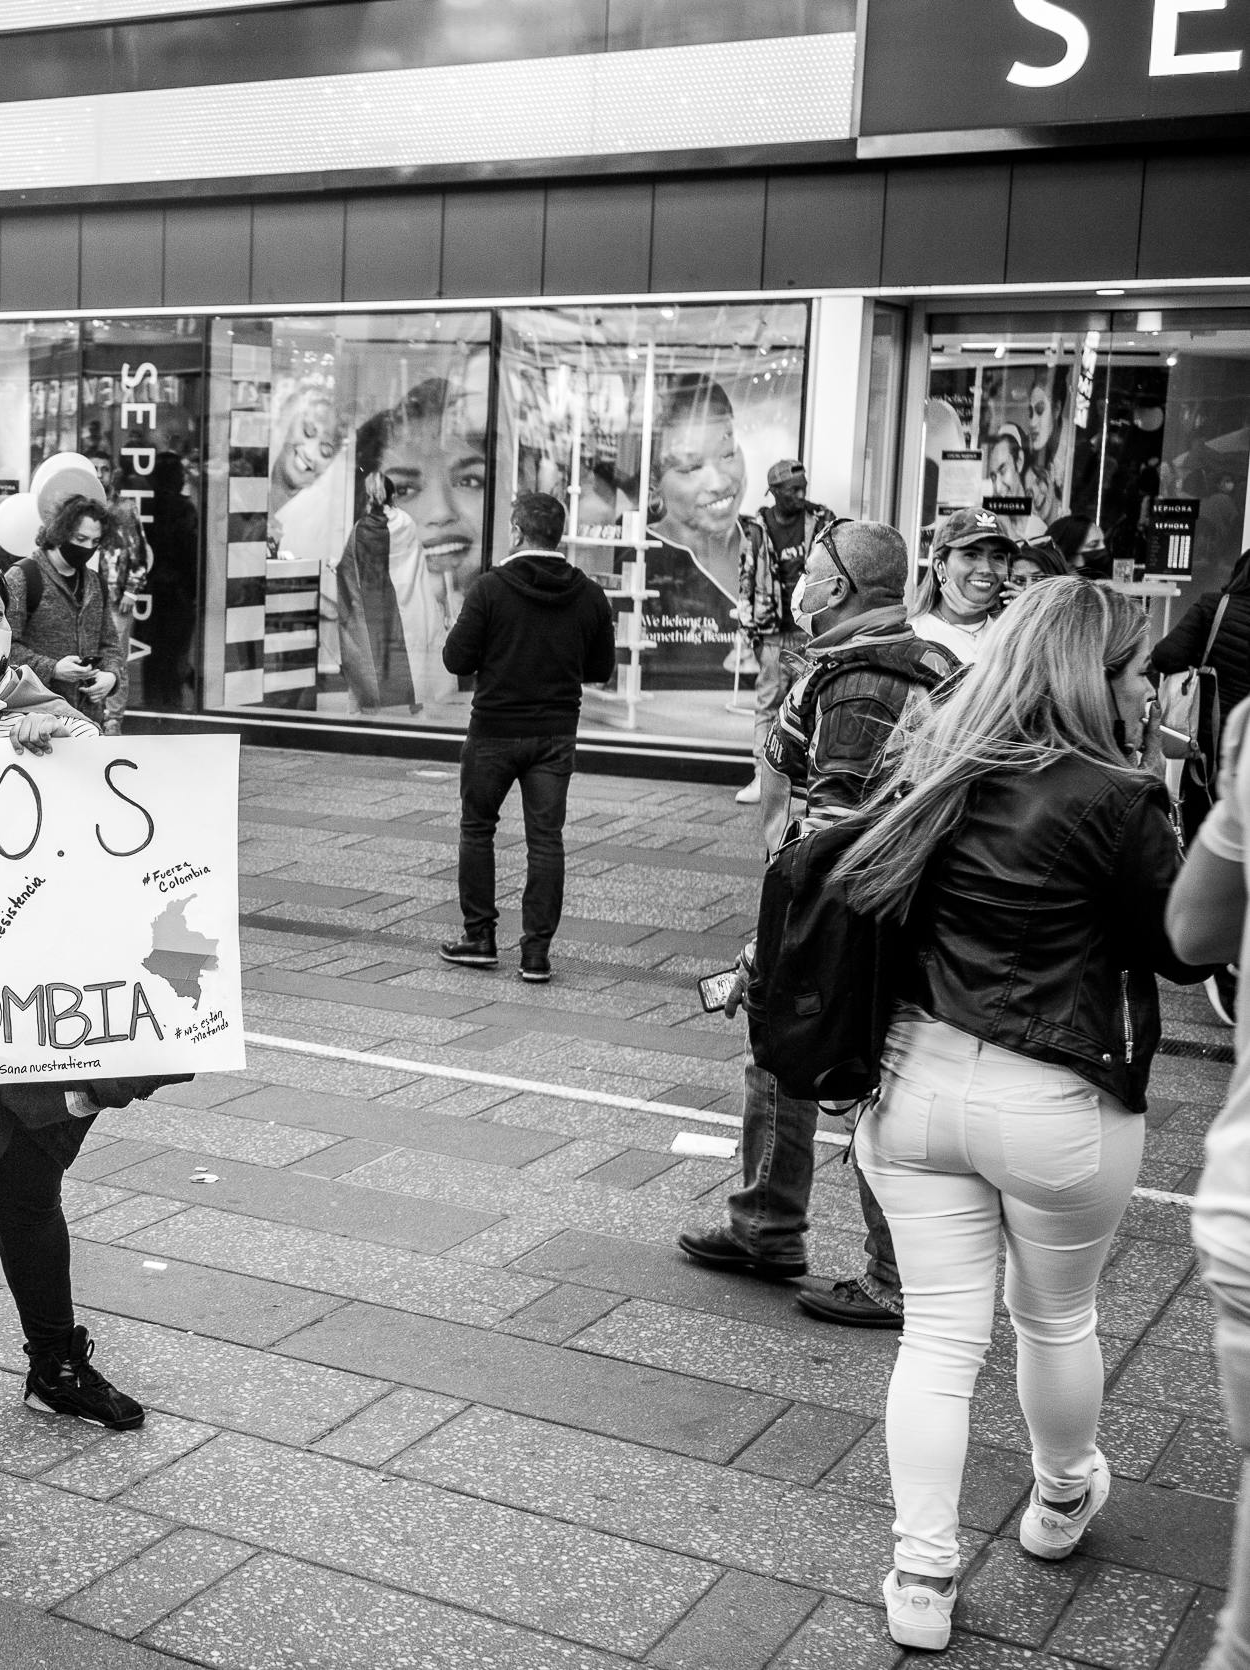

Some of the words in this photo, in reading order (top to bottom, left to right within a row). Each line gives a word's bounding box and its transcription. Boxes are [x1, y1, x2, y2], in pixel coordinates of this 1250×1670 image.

[120, 361, 158, 662] SEPHRA
[988, 502, 1025, 511] SEPHORA
[1155, 522, 1189, 530] SEPHORA
[644, 630, 702, 645] omething
[158, 866, 211, 893] Colombia
